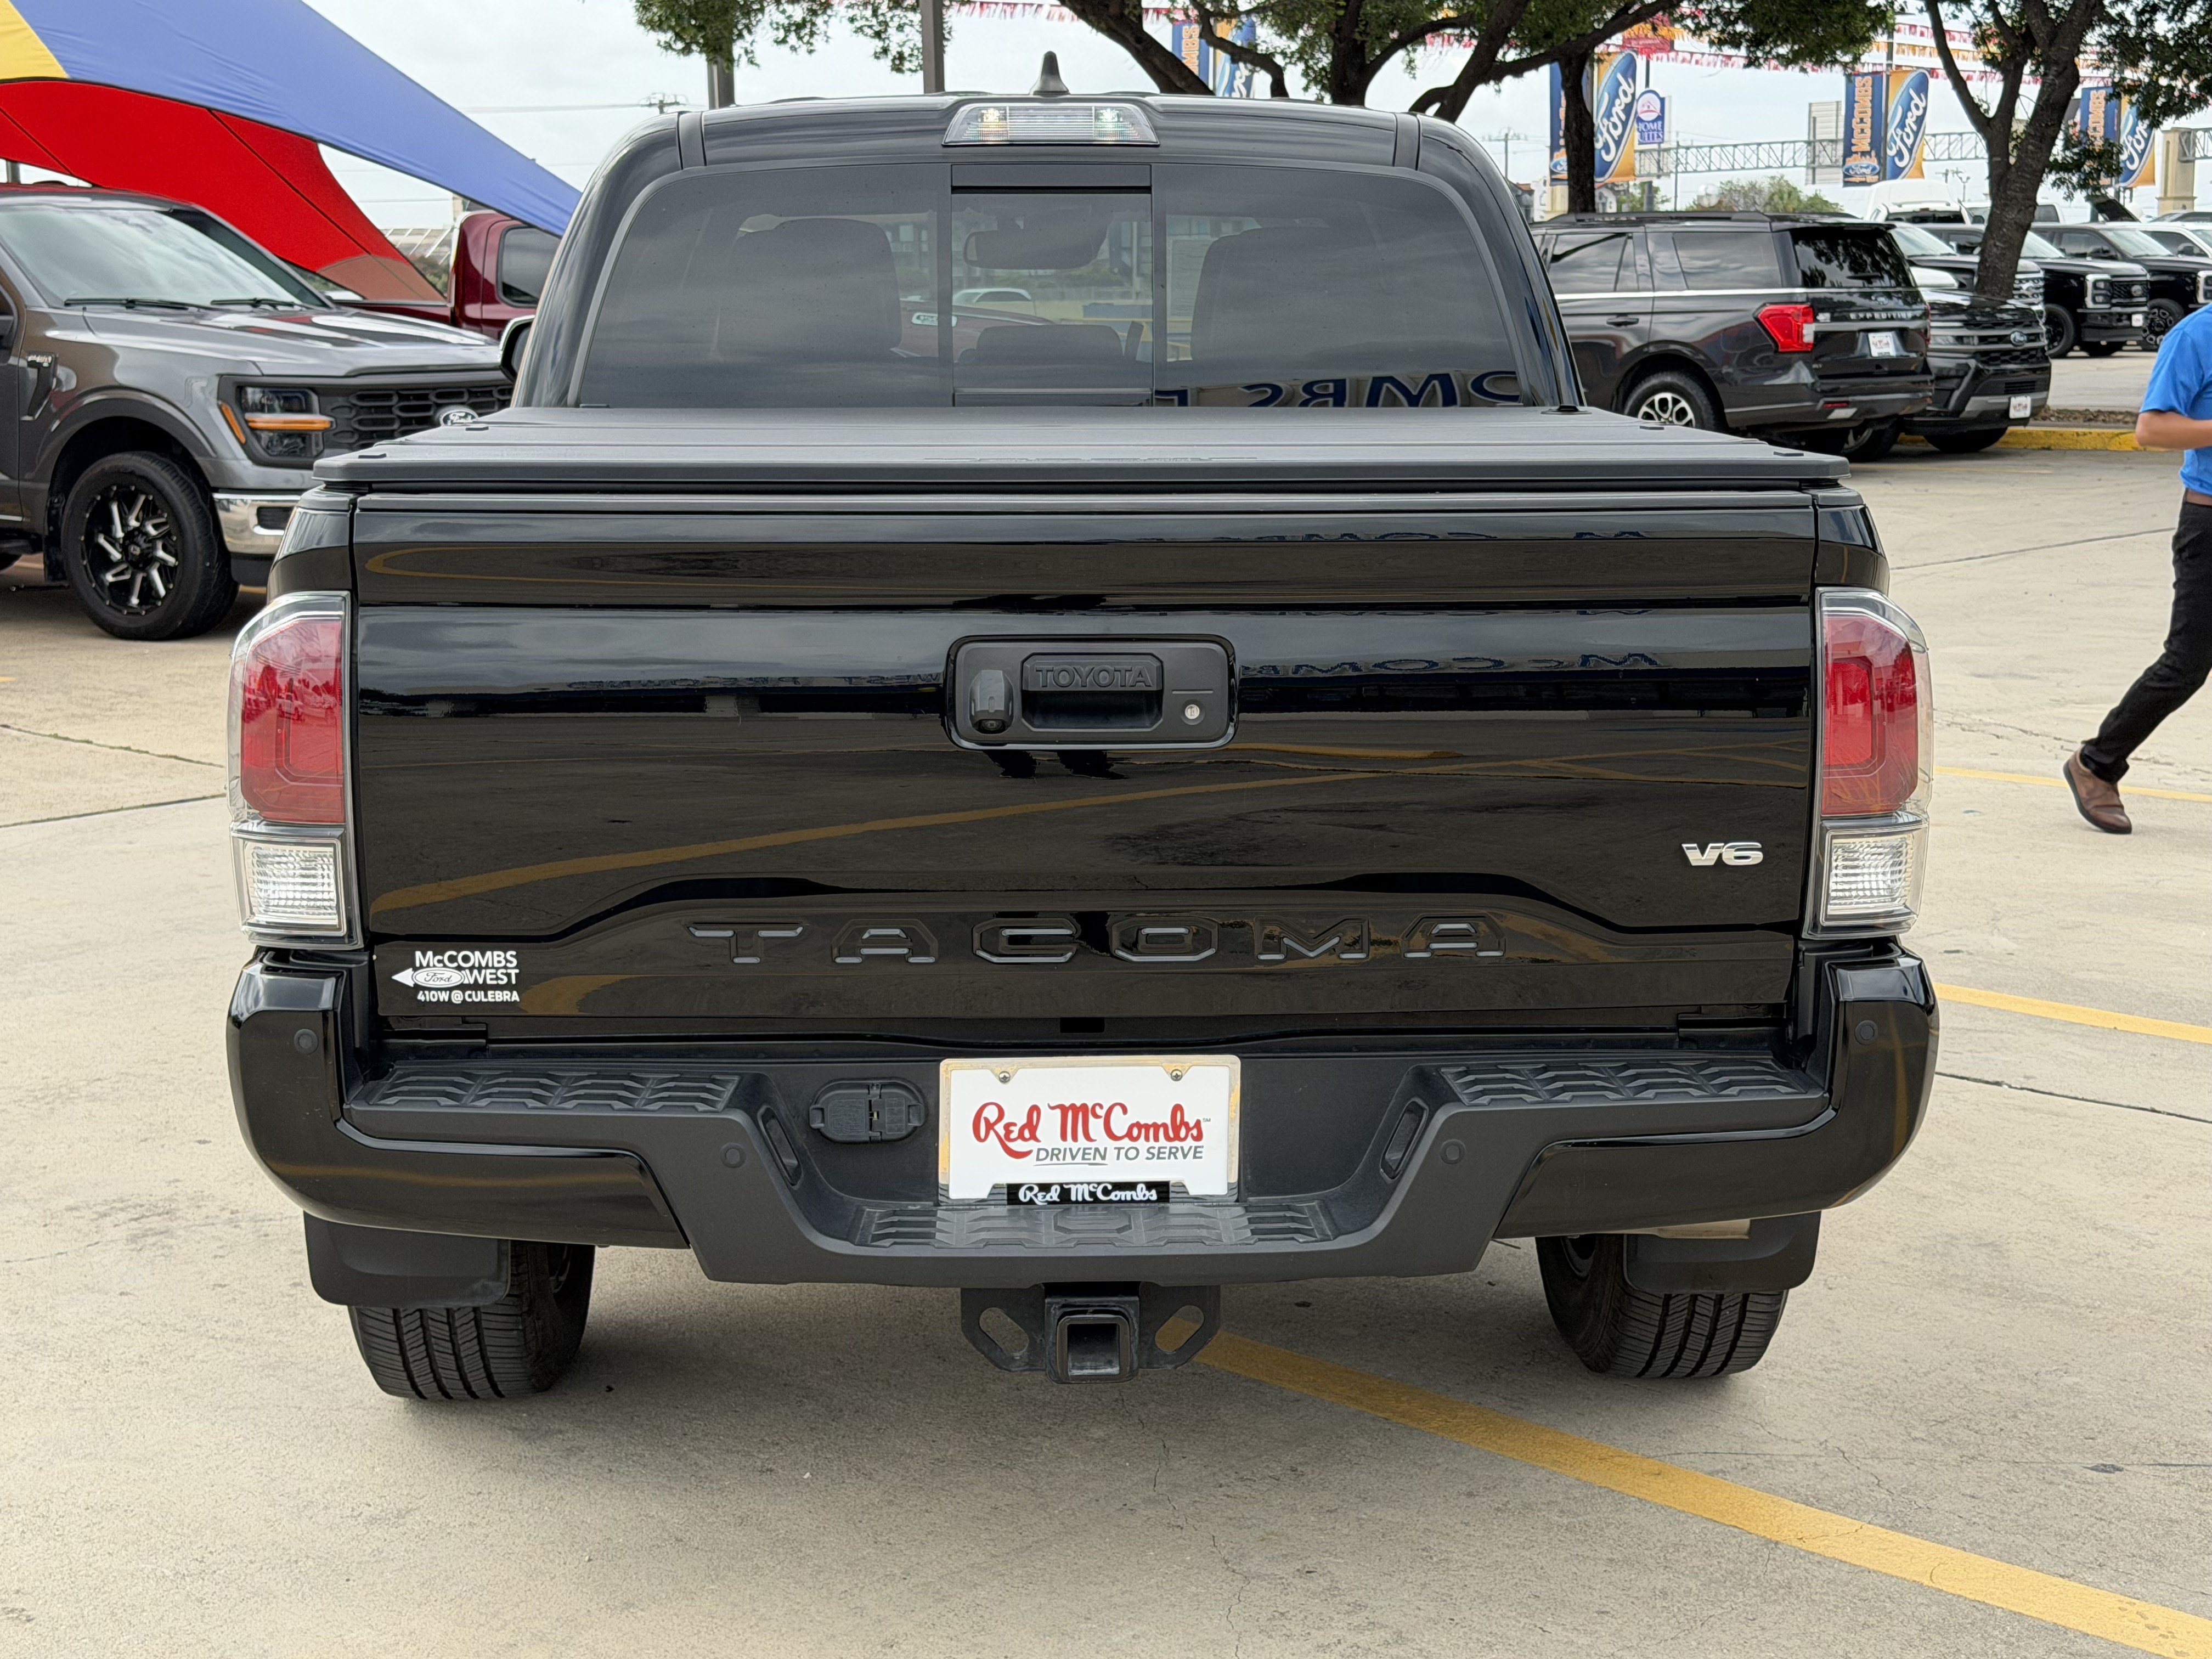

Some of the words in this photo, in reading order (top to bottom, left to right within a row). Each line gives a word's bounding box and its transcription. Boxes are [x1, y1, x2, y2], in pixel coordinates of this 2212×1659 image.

[1594, 72, 1635, 162] Ford
[1887, 87, 1926, 168] Ford
[1035, 665, 1152, 687] TOYOTA
[1681, 842, 1763, 866] V6
[687, 913, 1506, 964] TACOMA
[415, 950, 517, 967] McCOMBS
[424, 972, 453, 983] Ford
[466, 969, 520, 985] WEST
[465, 990, 520, 1002] CULEBRA
[972, 1102, 1042, 1159] Red
[1047, 1102, 1204, 1143] McCombs
[1035, 1147, 1108, 1162] DRIVEN
[1114, 1147, 1140, 1161] TO
[1145, 1145, 1204, 1160] SERVE
[1018, 1184, 1061, 1205] Red
[1063, 1183, 1158, 1201] McCombs
